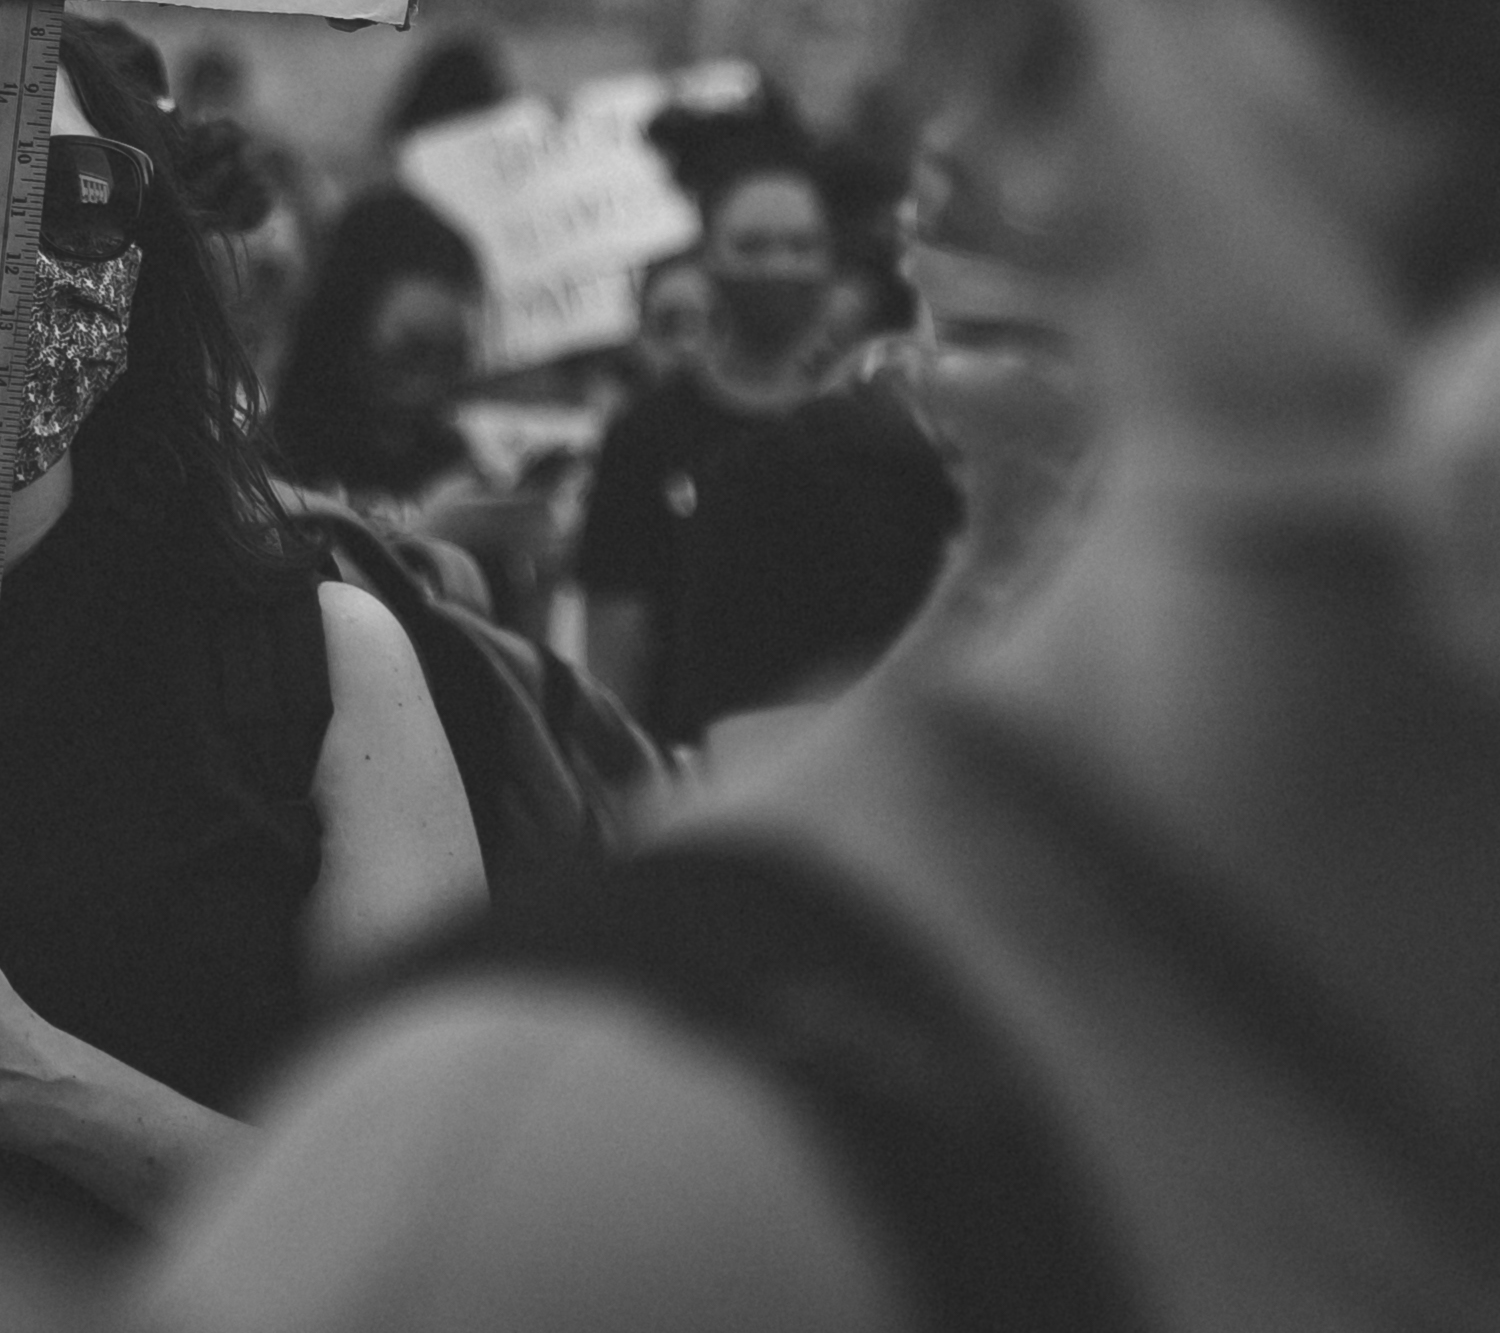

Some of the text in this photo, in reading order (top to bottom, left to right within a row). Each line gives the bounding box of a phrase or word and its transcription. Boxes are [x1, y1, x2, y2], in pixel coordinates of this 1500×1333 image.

[30, 26, 46, 37] 8
[24, 83, 39, 94] 9
[17, 139, 34, 164] 10
[10, 196, 27, 217] 11
[4, 252, 21, 275] 12
